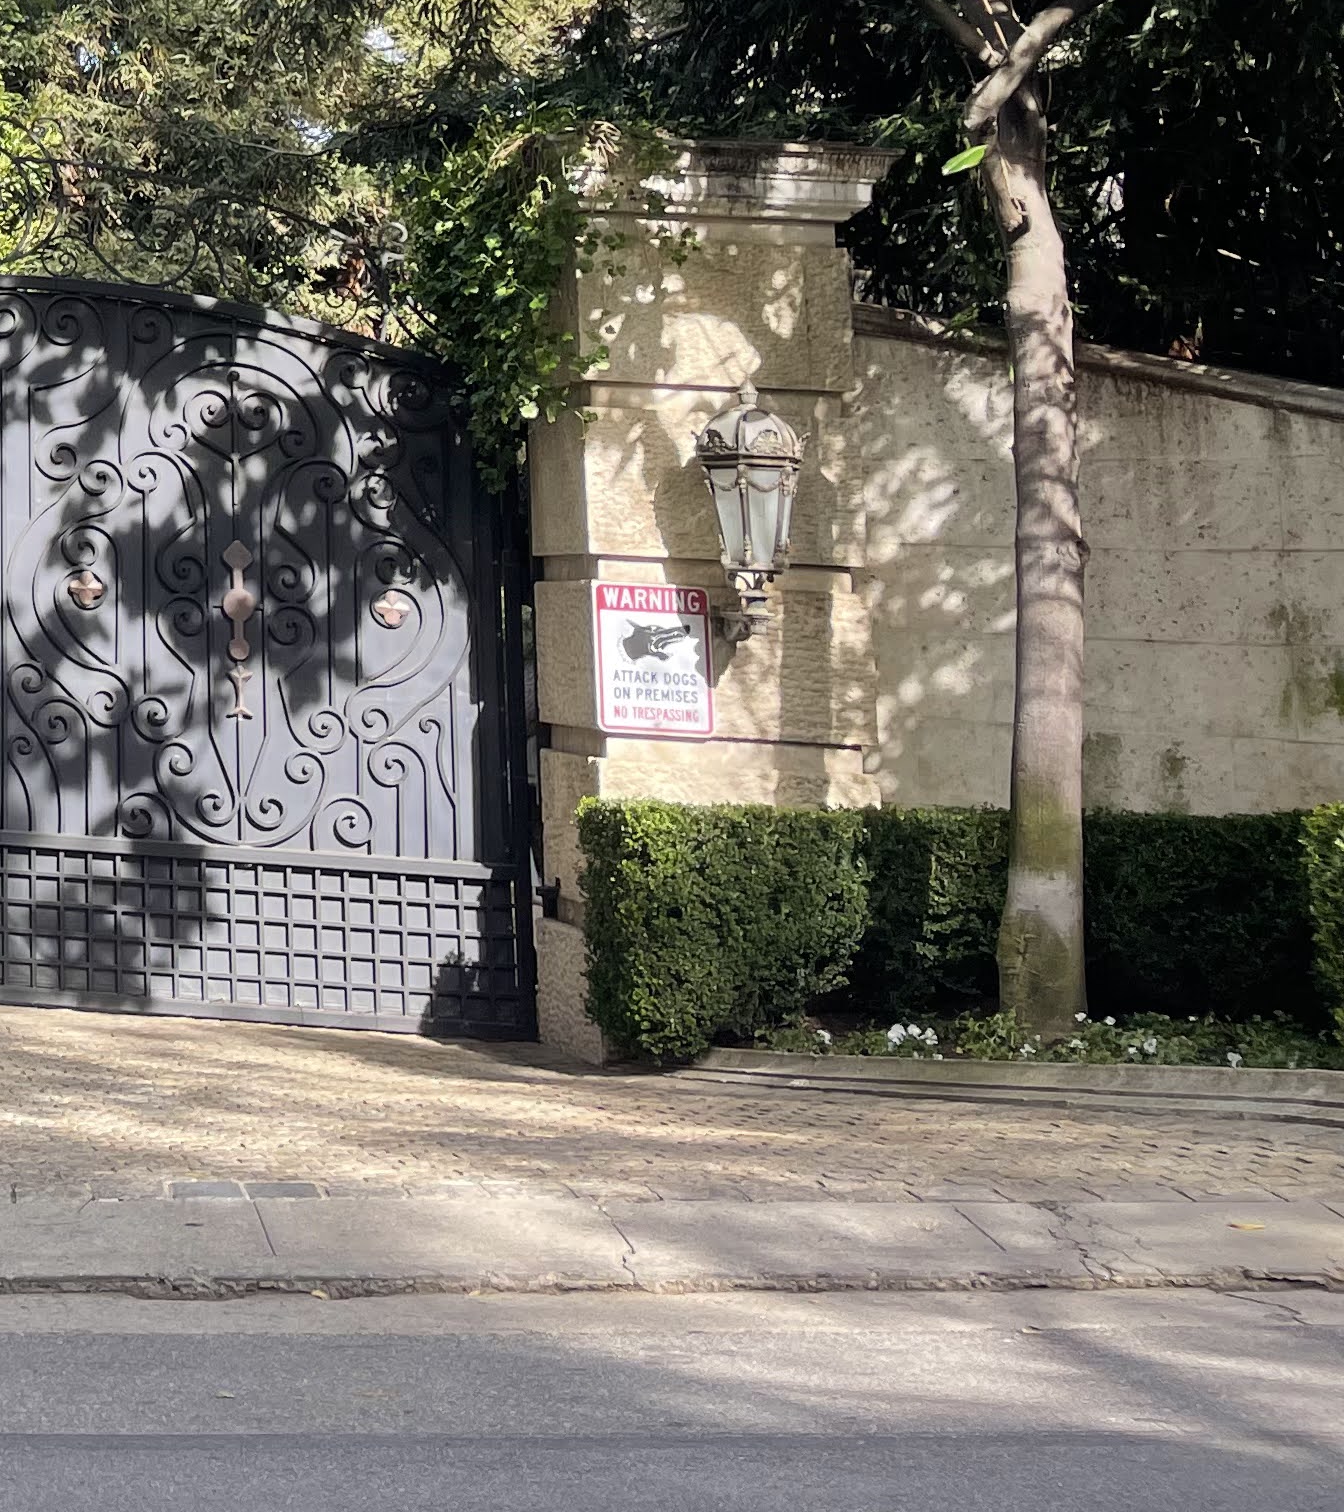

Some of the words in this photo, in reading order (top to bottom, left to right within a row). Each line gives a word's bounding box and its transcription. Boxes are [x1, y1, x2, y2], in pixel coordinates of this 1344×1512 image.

[602, 586, 701, 613] WARNING
[613, 669, 659, 684] ATTACK
[663, 672, 698, 686] DOGS
[613, 687, 631, 700] ON
[636, 689, 699, 704] PREMISES
[613, 705, 628, 719] NO
[633, 707, 700, 723] TRESPASSING
